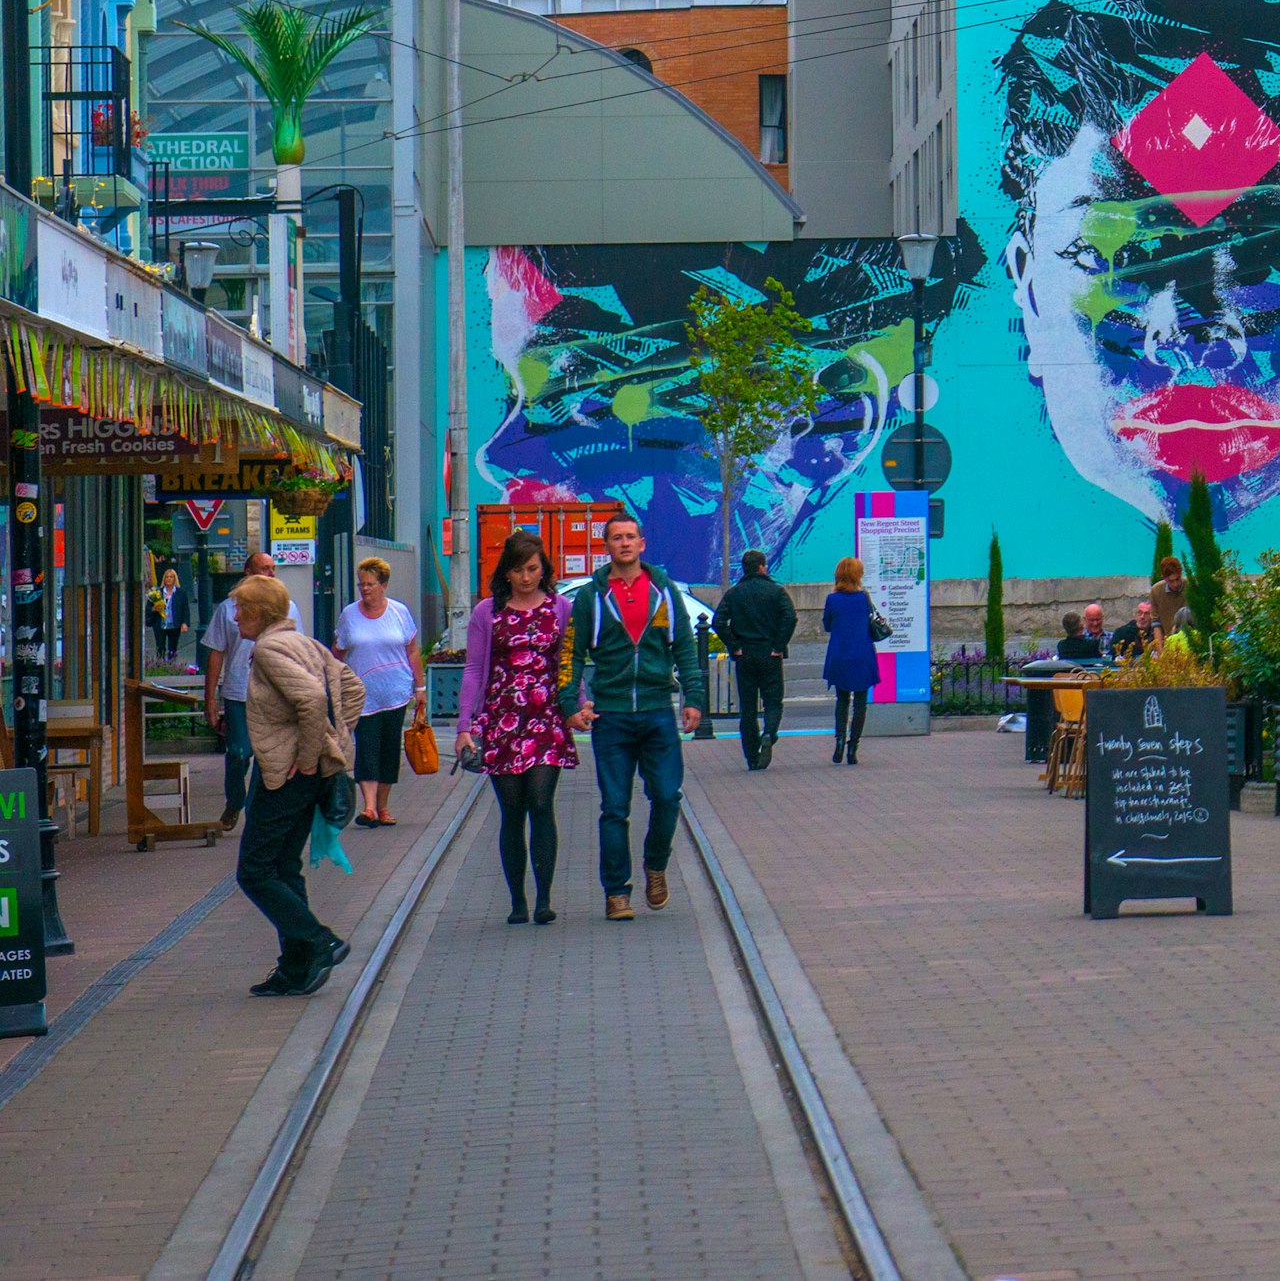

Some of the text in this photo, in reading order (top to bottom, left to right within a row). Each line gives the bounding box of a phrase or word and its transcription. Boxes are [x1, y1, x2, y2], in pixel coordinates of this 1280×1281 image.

[147, 139, 244, 155] ATHEDRAL
[62, 439, 105, 454] Fresh
[111, 438, 175, 453] Cookies
[286, 526, 311, 534] TRAMS
[877, 520, 899, 528] Regent
[1096, 731, 1204, 762] twenty seven steps
[0, 949, 31, 962] AGES
[0, 968, 32, 982] ATED
